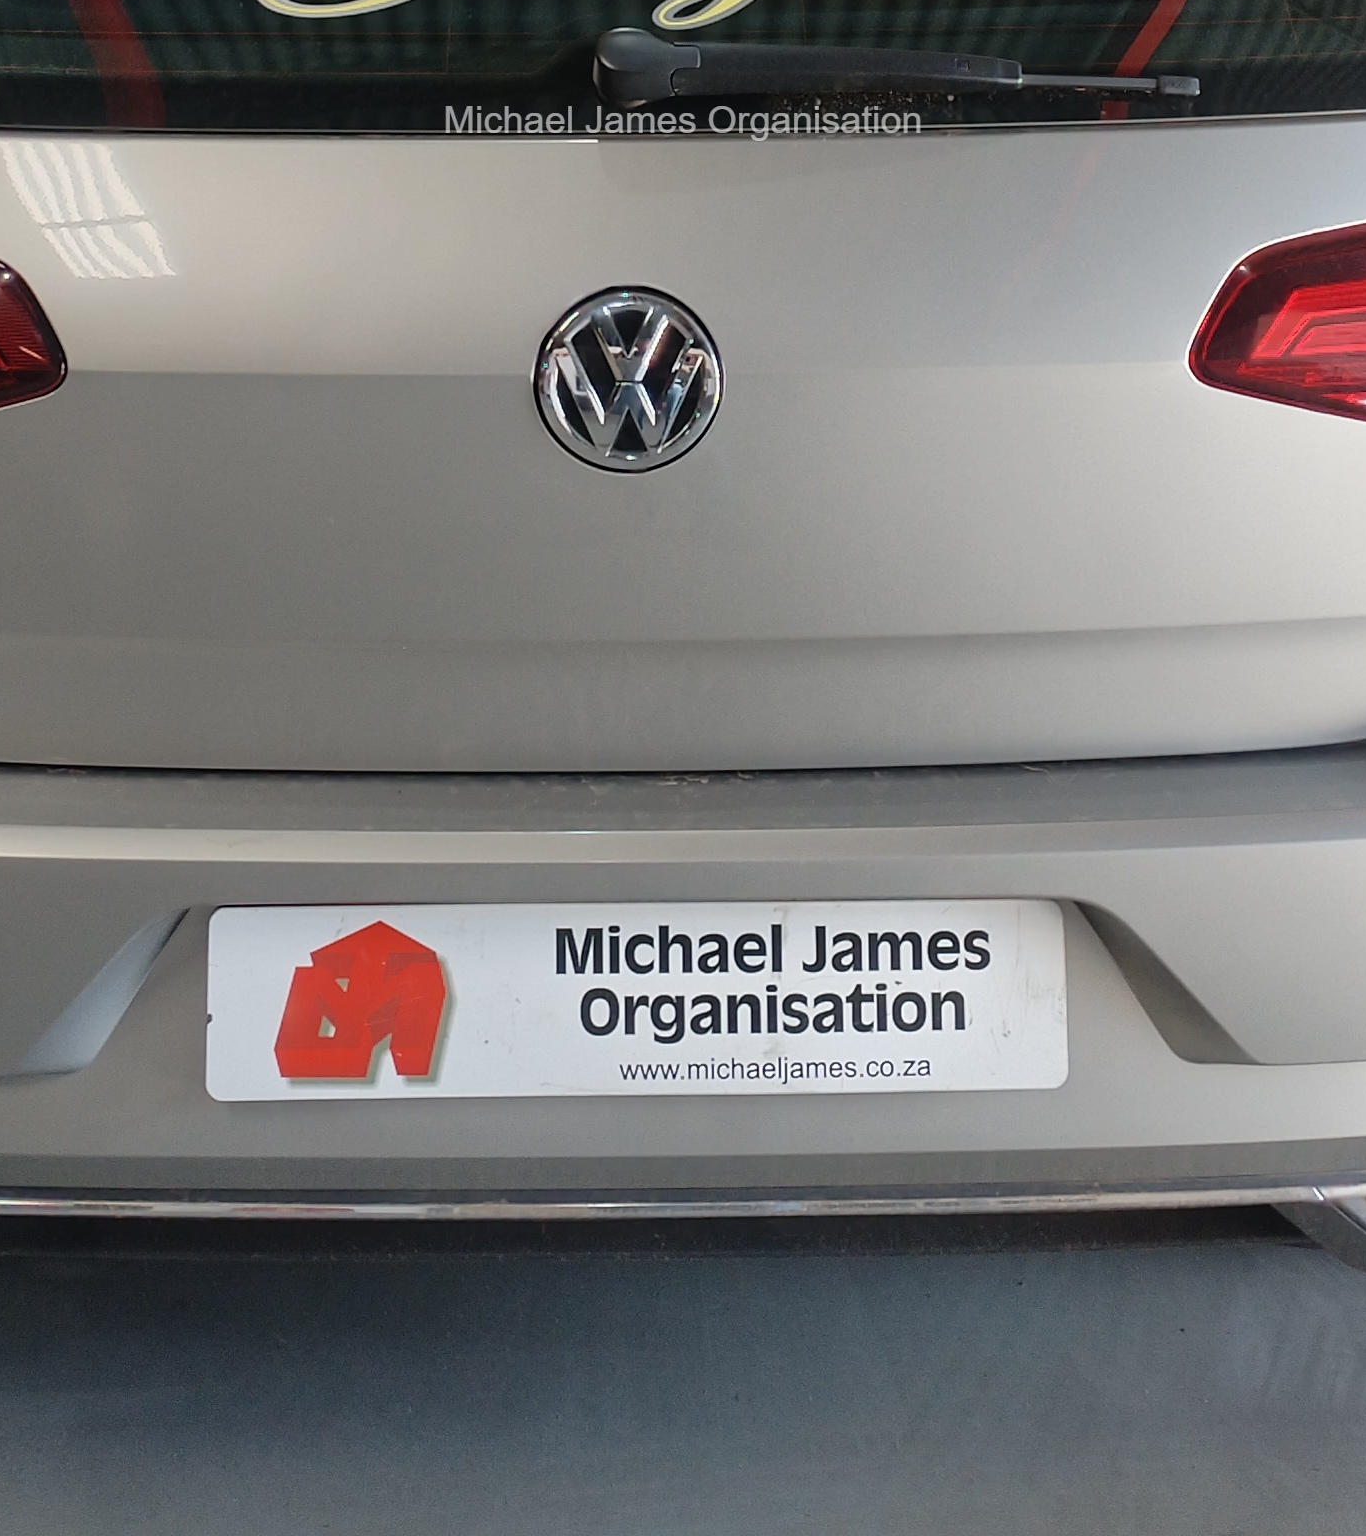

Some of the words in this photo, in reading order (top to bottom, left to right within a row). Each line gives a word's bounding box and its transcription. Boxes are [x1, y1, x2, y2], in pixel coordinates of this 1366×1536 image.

[554, 924, 784, 975] Michael
[801, 924, 992, 973] James
[578, 982, 966, 1044] Organisation
[619, 1056, 931, 1087] www.michaeljames.co.za
